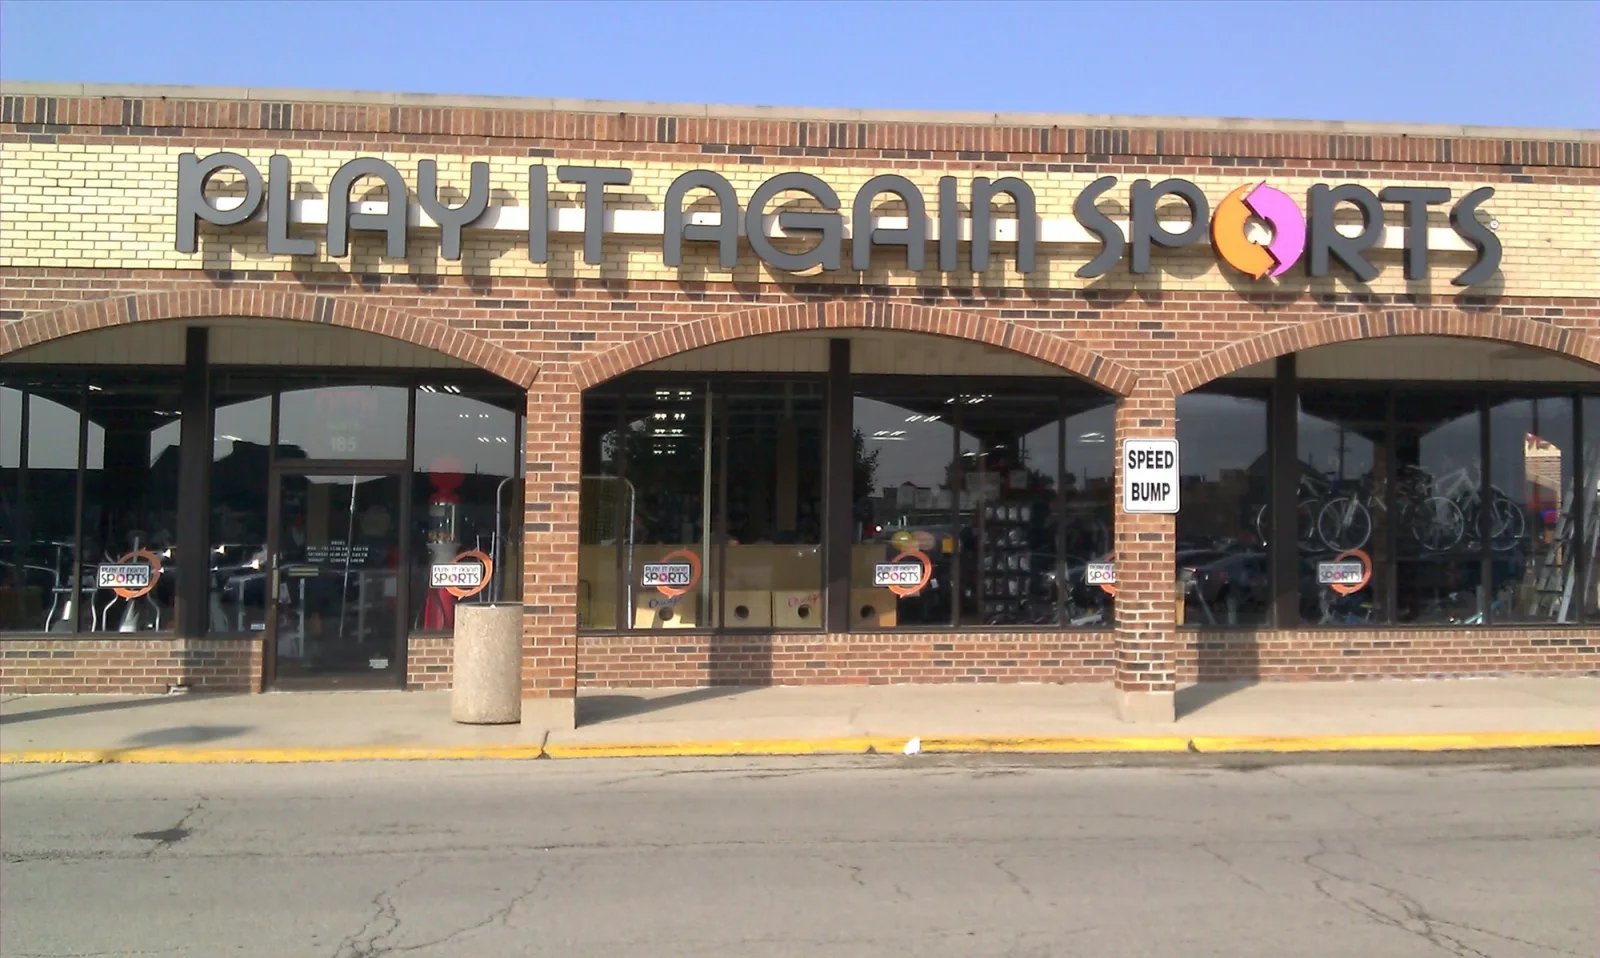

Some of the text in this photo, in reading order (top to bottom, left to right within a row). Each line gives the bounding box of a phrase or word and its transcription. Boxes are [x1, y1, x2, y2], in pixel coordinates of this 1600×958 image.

[174, 151, 1503, 288] PLAY IT AGAIN SPORTS
[1128, 449, 1174, 469] SPEED
[1131, 482, 1171, 501] BUMP
[101, 573, 148, 584] SPORTS
[433, 573, 480, 584] SPORTS
[645, 572, 689, 583] SPORTS
[876, 571, 919, 582] SPORTS
